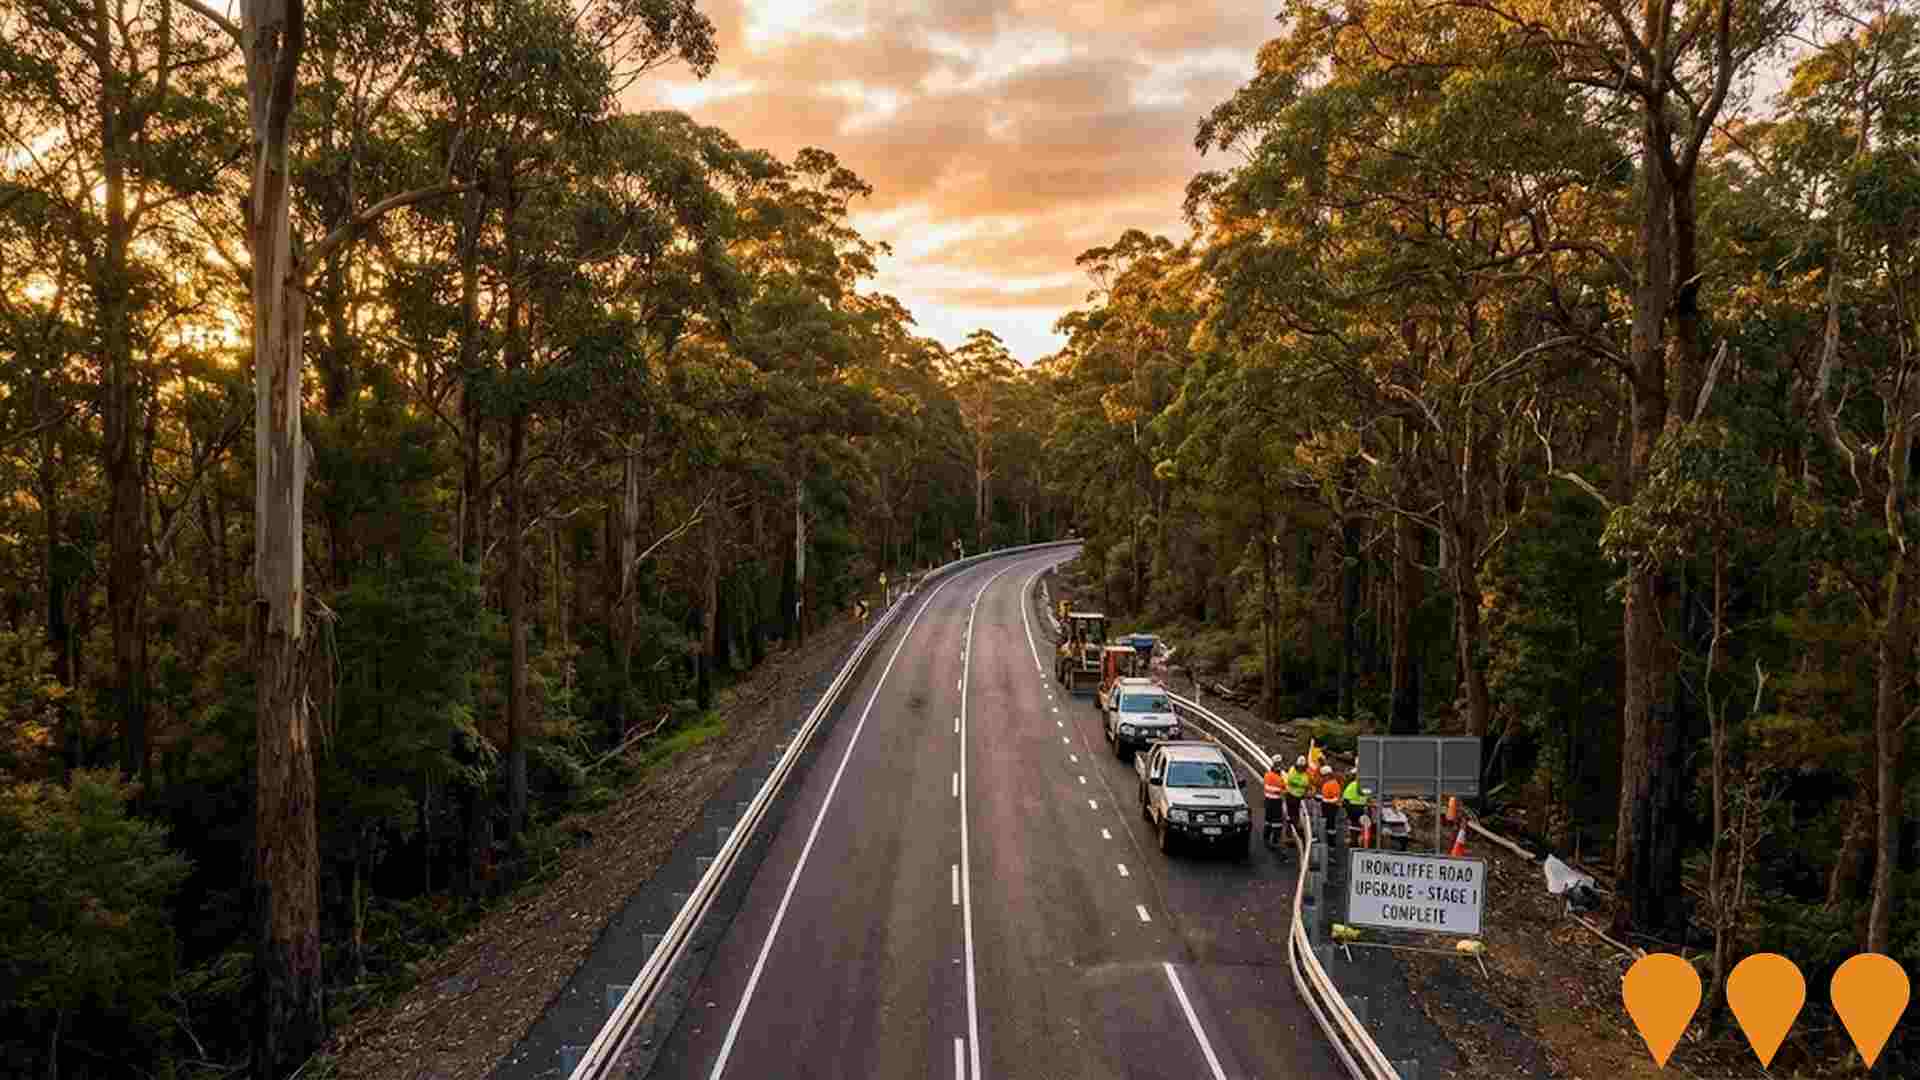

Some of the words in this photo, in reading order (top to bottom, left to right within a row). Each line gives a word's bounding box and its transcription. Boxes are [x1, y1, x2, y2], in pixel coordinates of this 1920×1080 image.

[1360, 859, 1434, 880] IRONCLIFFE
[1440, 864, 1473, 882] ROAD
[1354, 879, 1414, 900] UPGRADE
[1427, 884, 1468, 905] STAGE
[1381, 903, 1447, 924] COMPLETE
